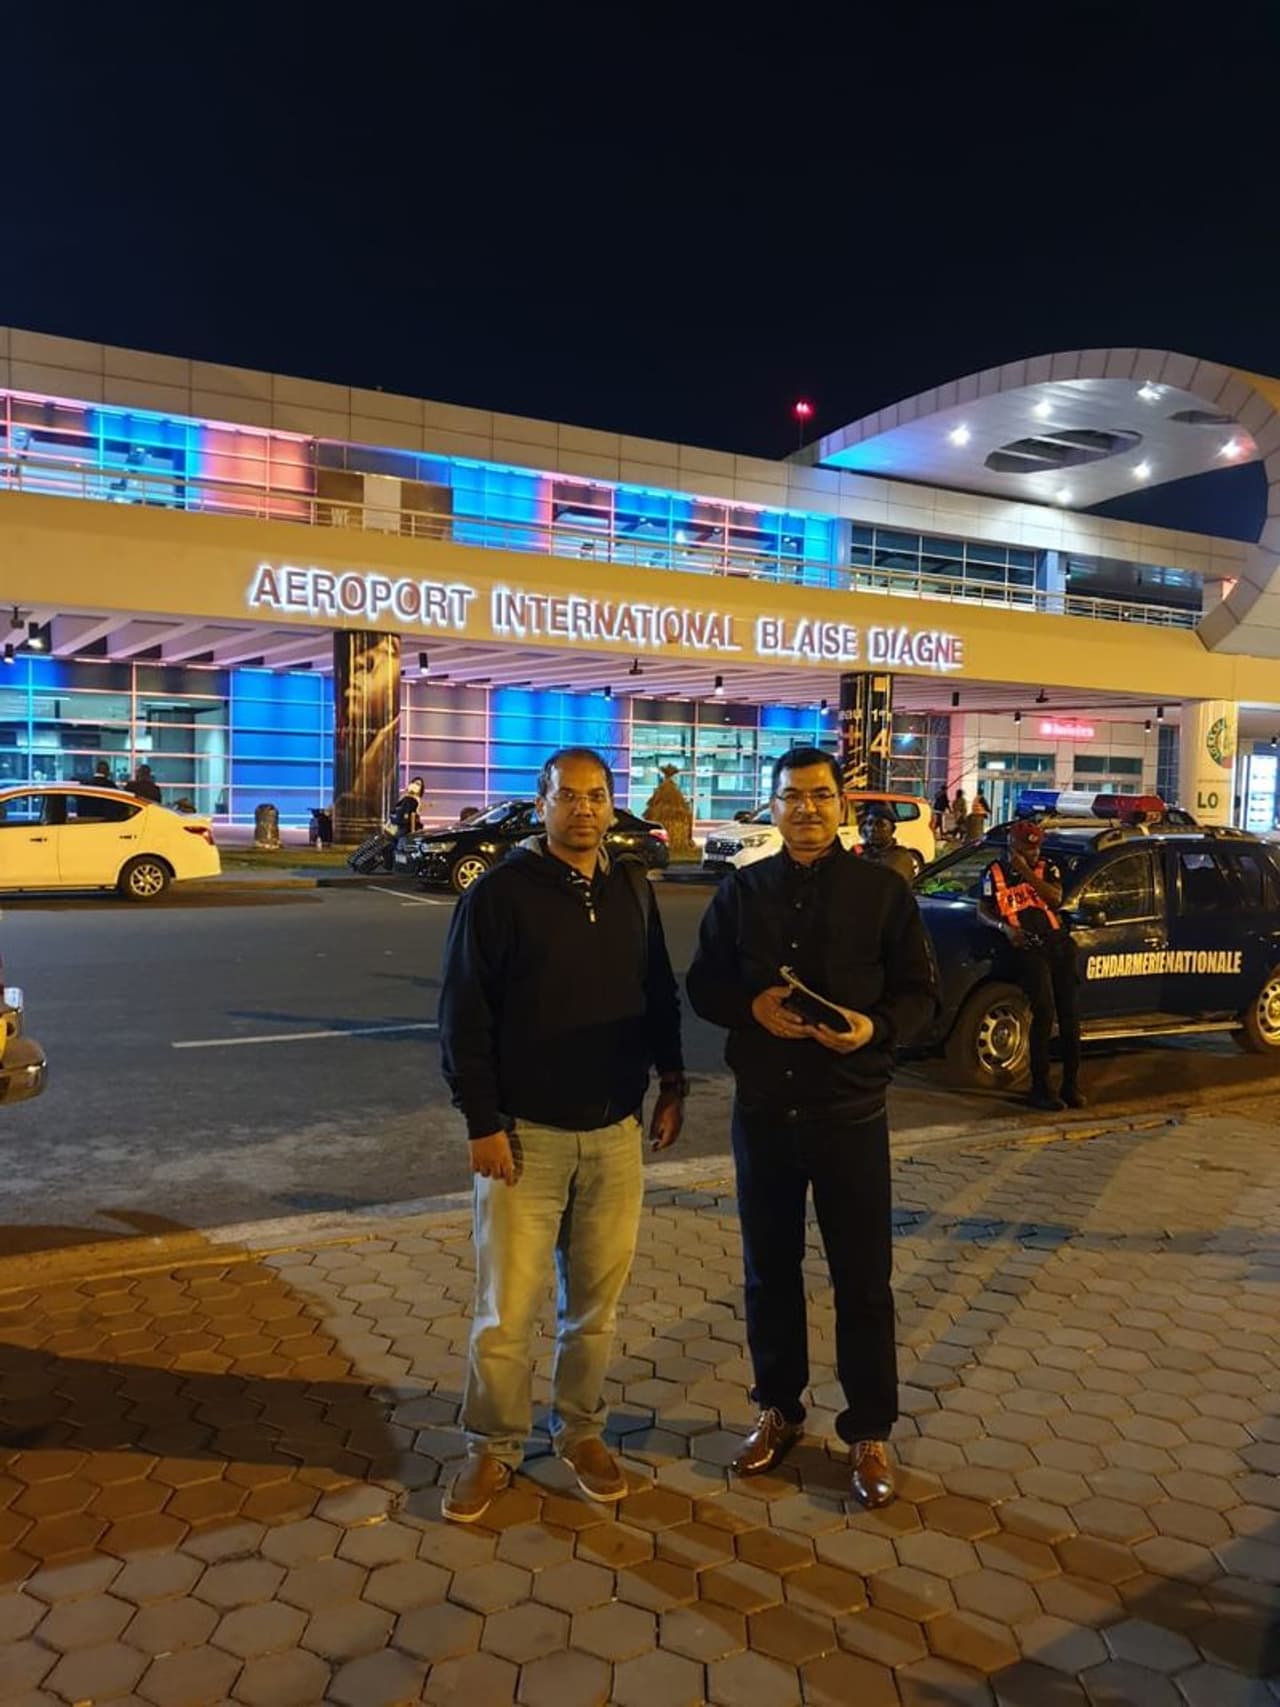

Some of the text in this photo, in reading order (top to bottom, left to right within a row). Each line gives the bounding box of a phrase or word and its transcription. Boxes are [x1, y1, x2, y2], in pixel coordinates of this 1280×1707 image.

[251, 565, 964, 670] AEROPORT INTERNATIONAL BLAISE DIAGNE
